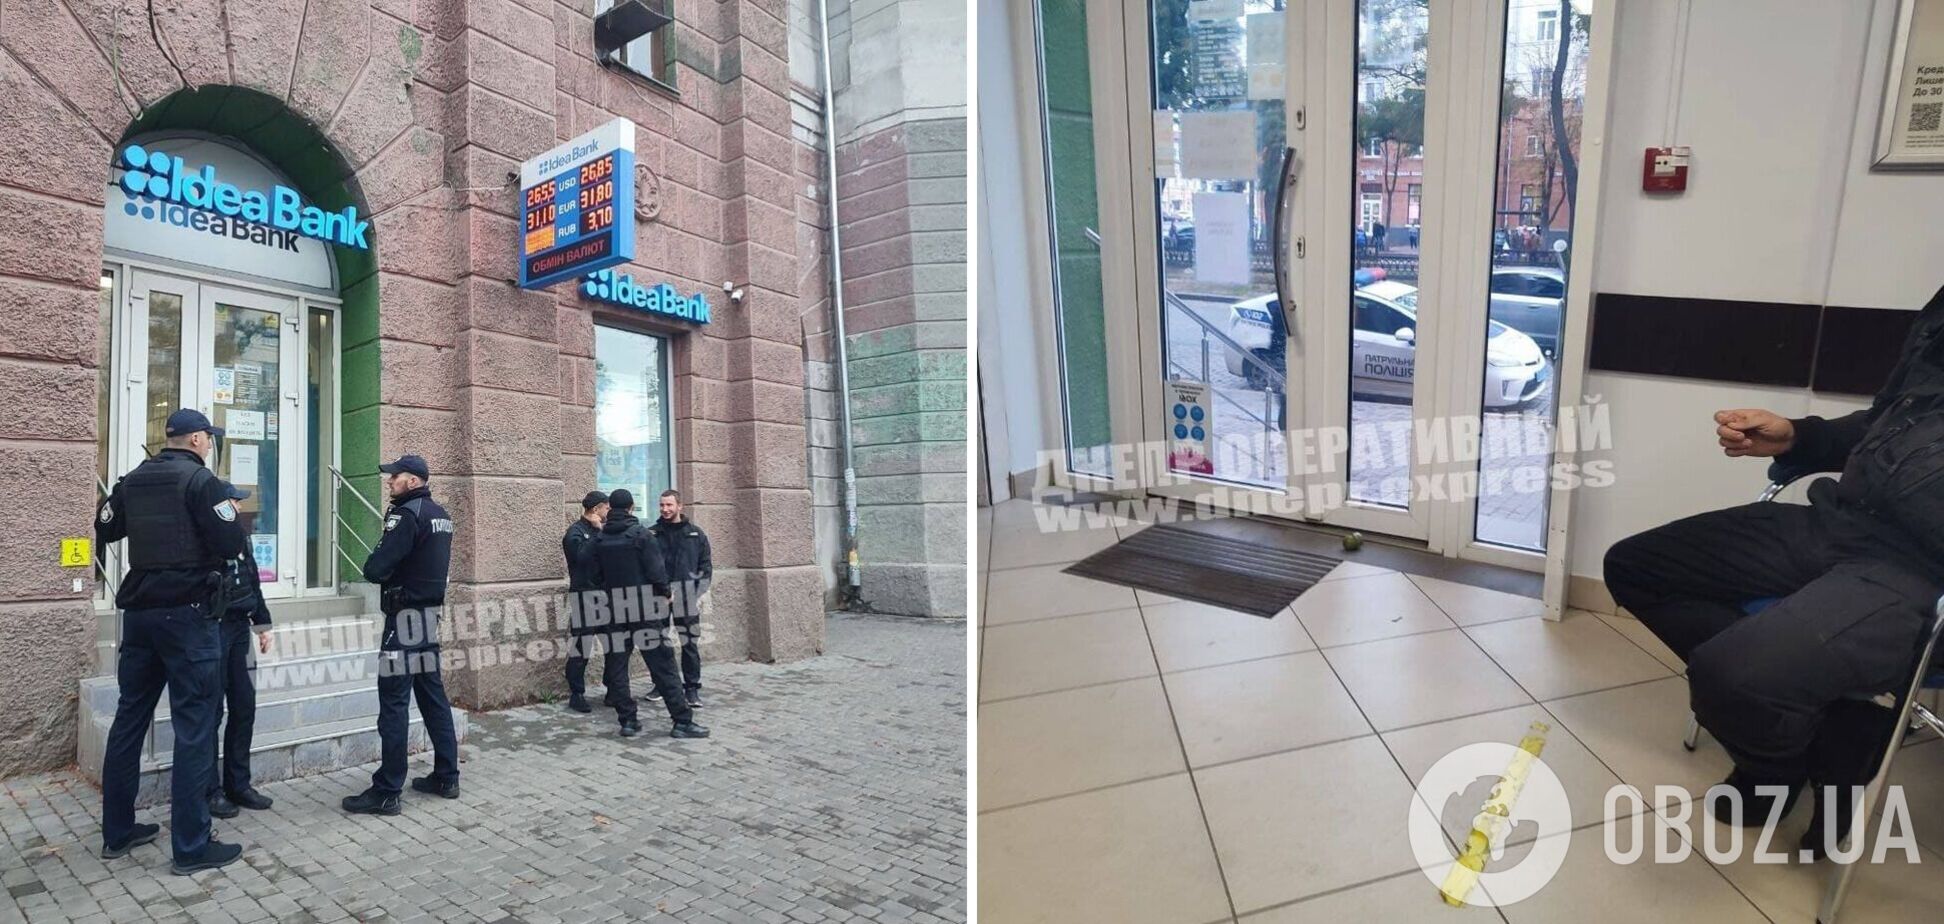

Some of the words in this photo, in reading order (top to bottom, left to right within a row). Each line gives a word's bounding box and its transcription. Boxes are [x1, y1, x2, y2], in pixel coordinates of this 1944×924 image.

[1912, 88, 1927, 97] До
[1930, 87, 1943, 96] 30
[549, 154, 571, 170] Idea
[572, 139, 599, 161] Bank
[559, 177, 577, 191] USD
[170, 156, 270, 223] Idea
[274, 185, 369, 249] Bank
[559, 200, 577, 215] EUR
[559, 223, 577, 238] RUB
[532, 255, 565, 273] ОБМІН
[566, 240, 605, 261] ВАЛЮТ
[612, 269, 660, 312] Idea
[662, 283, 712, 324] Bank
